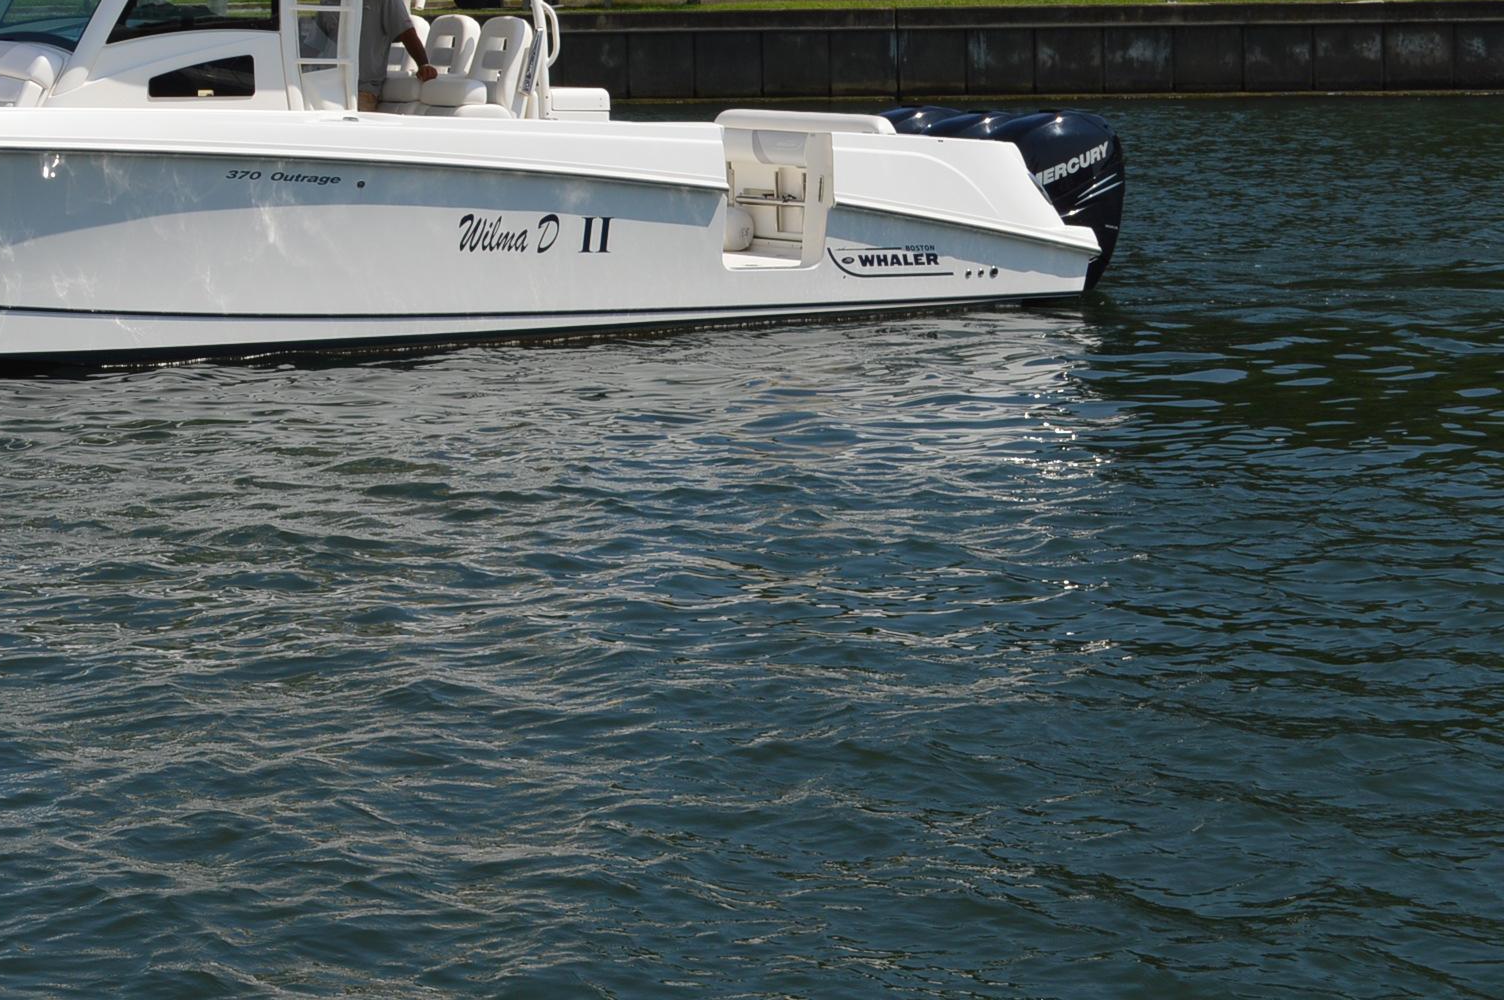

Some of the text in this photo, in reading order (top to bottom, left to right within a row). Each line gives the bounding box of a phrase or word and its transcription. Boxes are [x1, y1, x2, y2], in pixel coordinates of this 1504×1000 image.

[225, 169, 342, 185] 370 Outrage
[458, 213, 529, 253] Wilma
[537, 213, 560, 254] D
[905, 244, 936, 252] BOSTON
[858, 253, 940, 267] WHALER
